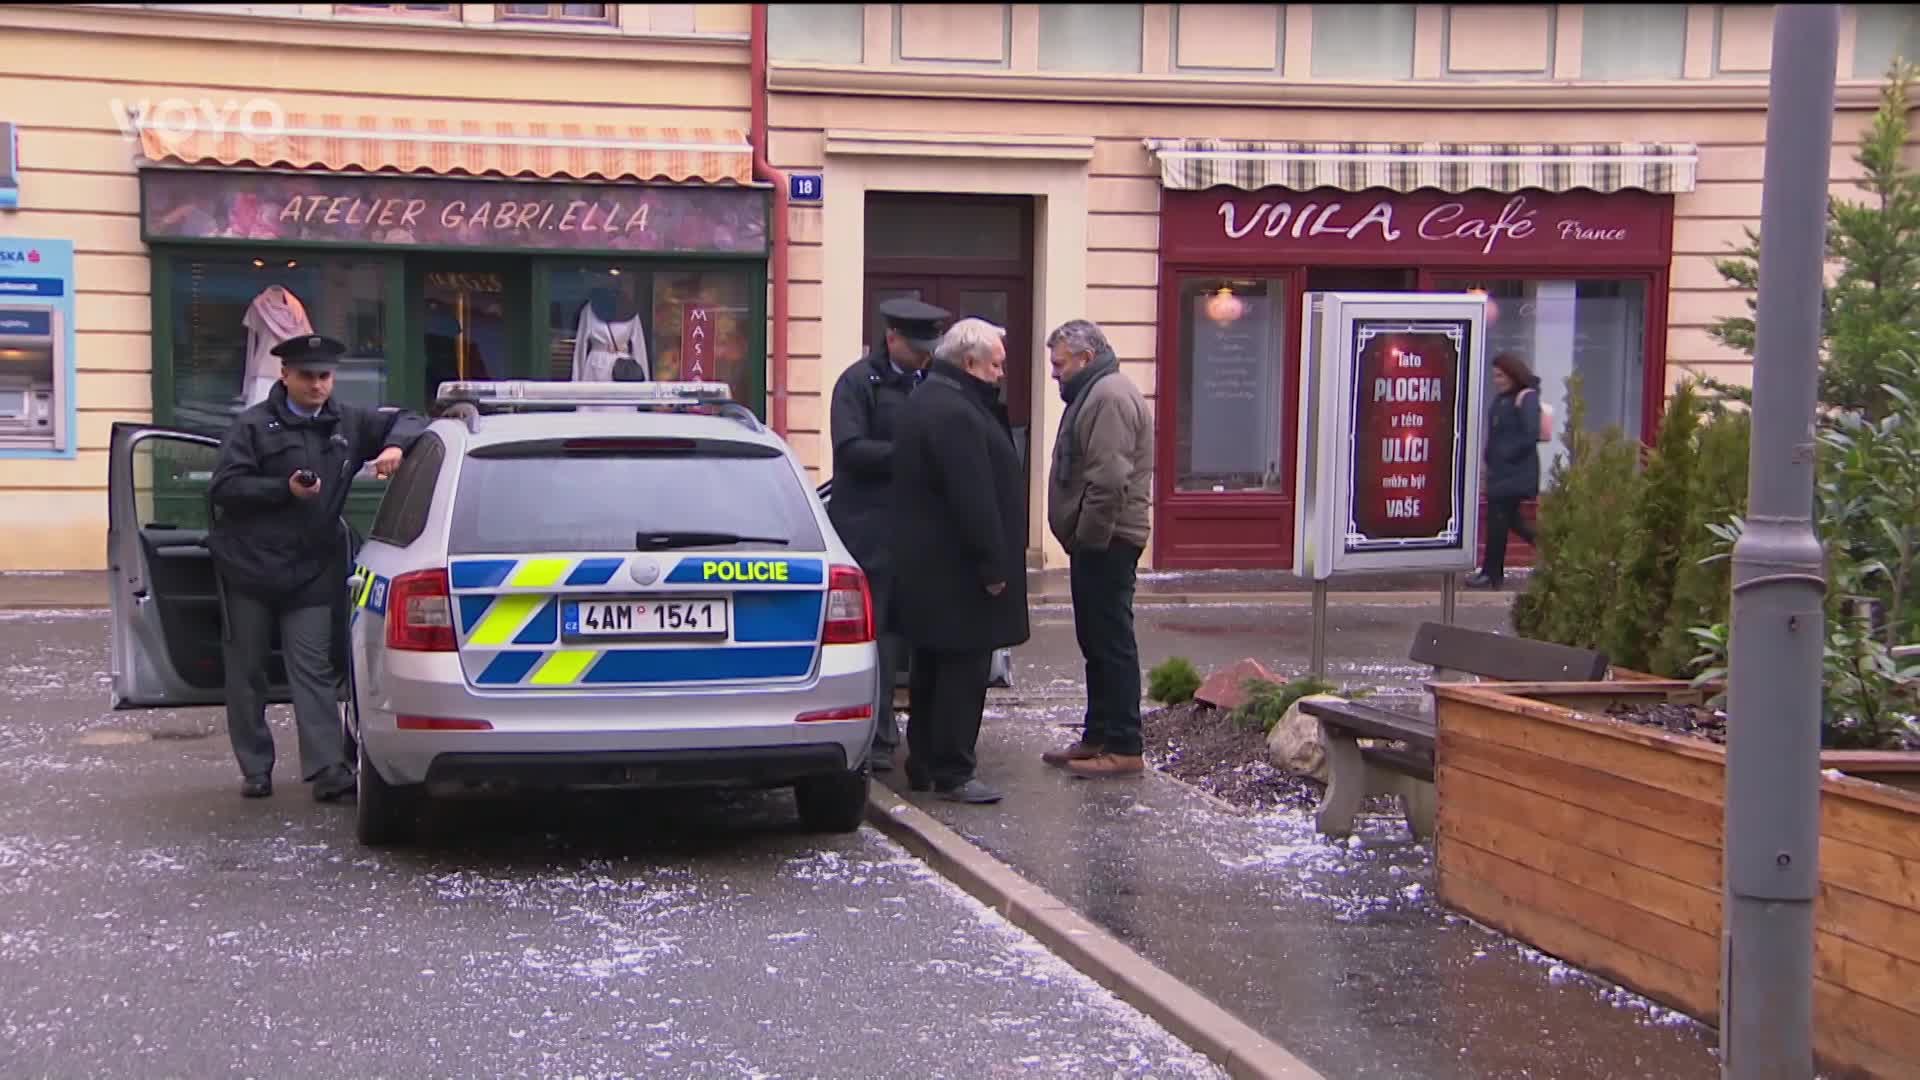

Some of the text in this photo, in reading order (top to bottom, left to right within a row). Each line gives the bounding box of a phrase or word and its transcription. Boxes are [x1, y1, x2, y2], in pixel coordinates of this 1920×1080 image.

[799, 180, 812, 194] 18
[280, 196, 425, 226] ATELIER
[1418, 196, 1537, 254] Café
[1557, 219, 1626, 241] France
[1397, 351, 1422, 367] Tato
[1374, 378, 1441, 402] PLOCHA
[1391, 411, 1423, 427] v této
[1411, 474, 1425, 489] být
[1386, 497, 1421, 518] VAŠE
[703, 561, 788, 581] POLICIE
[565, 604, 713, 631] CZ 4AM 1541
